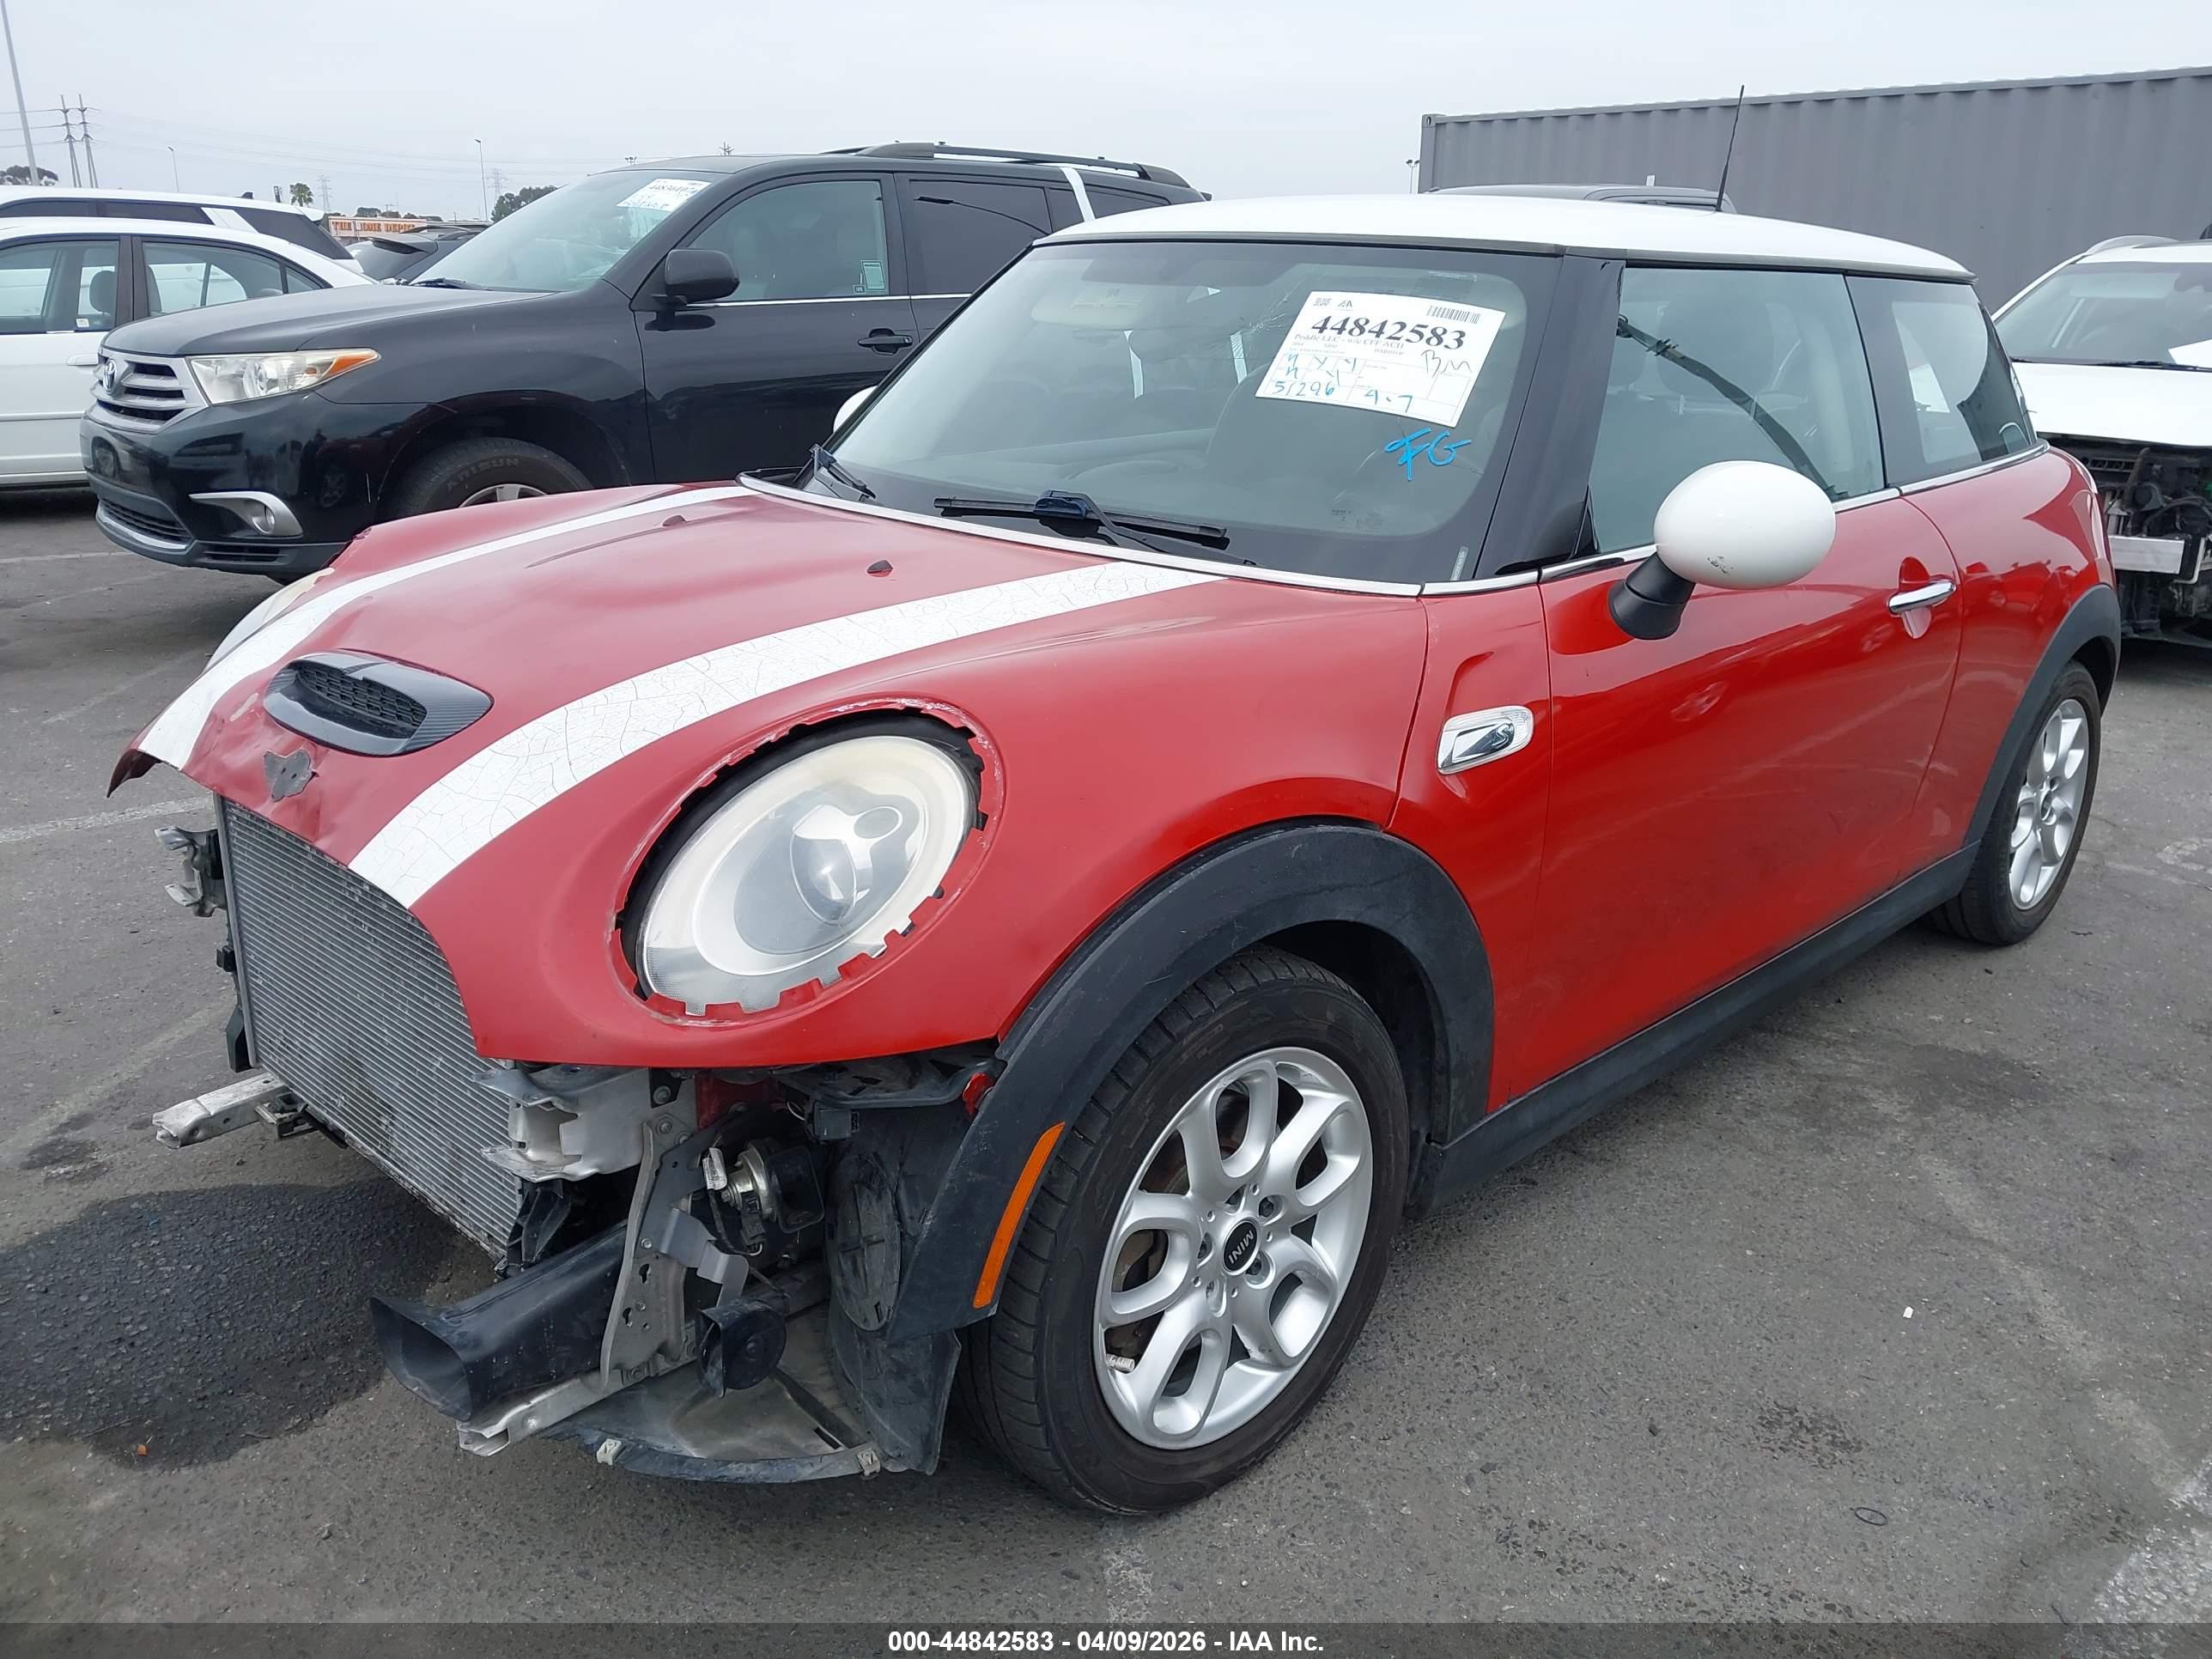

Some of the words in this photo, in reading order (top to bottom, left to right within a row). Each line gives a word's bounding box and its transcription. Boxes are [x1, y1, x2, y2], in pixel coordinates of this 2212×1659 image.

[331, 222, 352, 231] THE
[1310, 315, 1467, 350] 44842583
[1228, 1229, 1255, 1265] MINI
